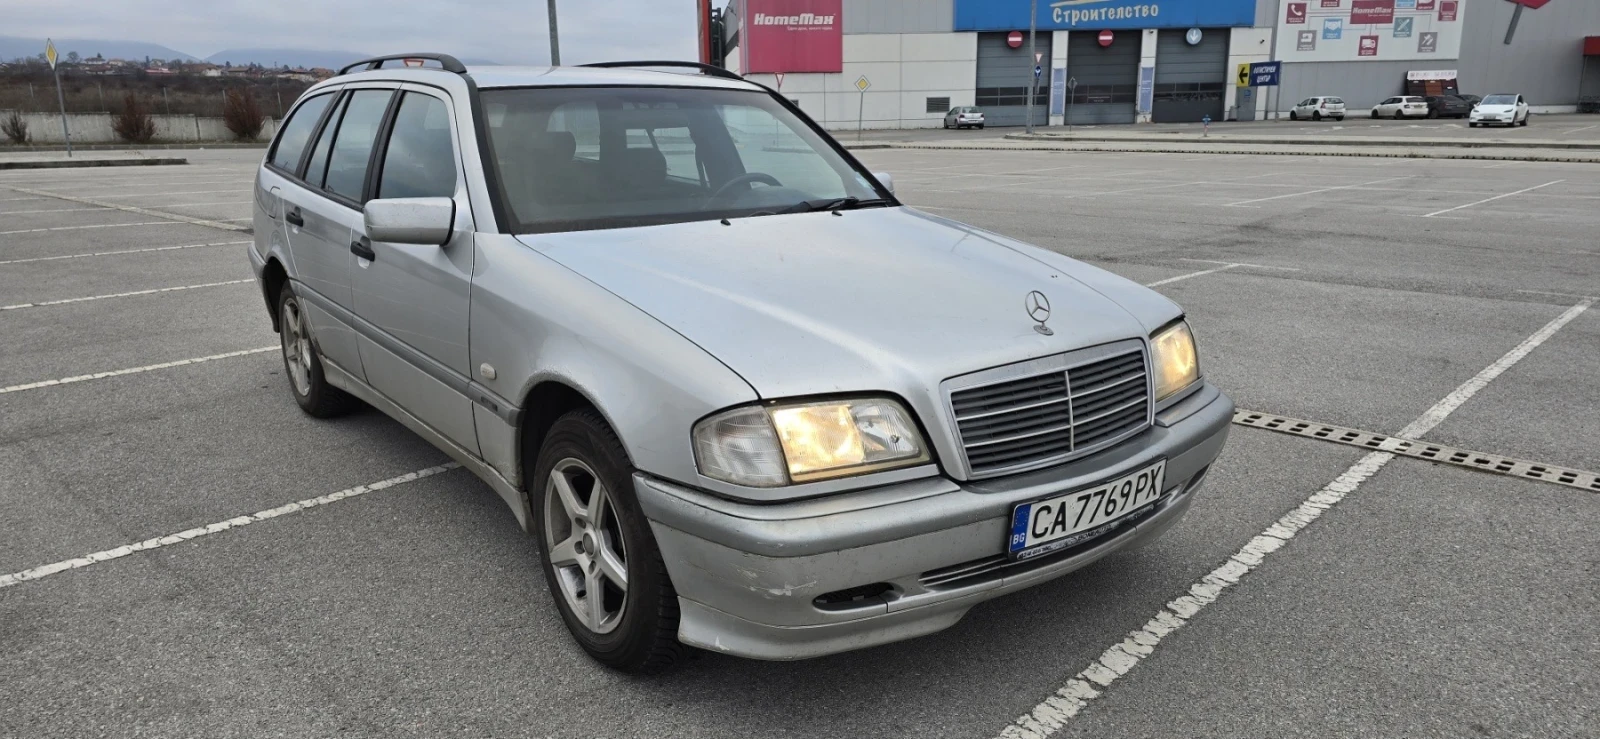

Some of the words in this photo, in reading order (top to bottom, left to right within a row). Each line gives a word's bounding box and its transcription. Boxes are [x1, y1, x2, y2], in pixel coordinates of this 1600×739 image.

[754, 13, 834, 25] HomeMax
[1053, 4, 1158, 25] Строителство
[1013, 532, 1025, 545] BG
